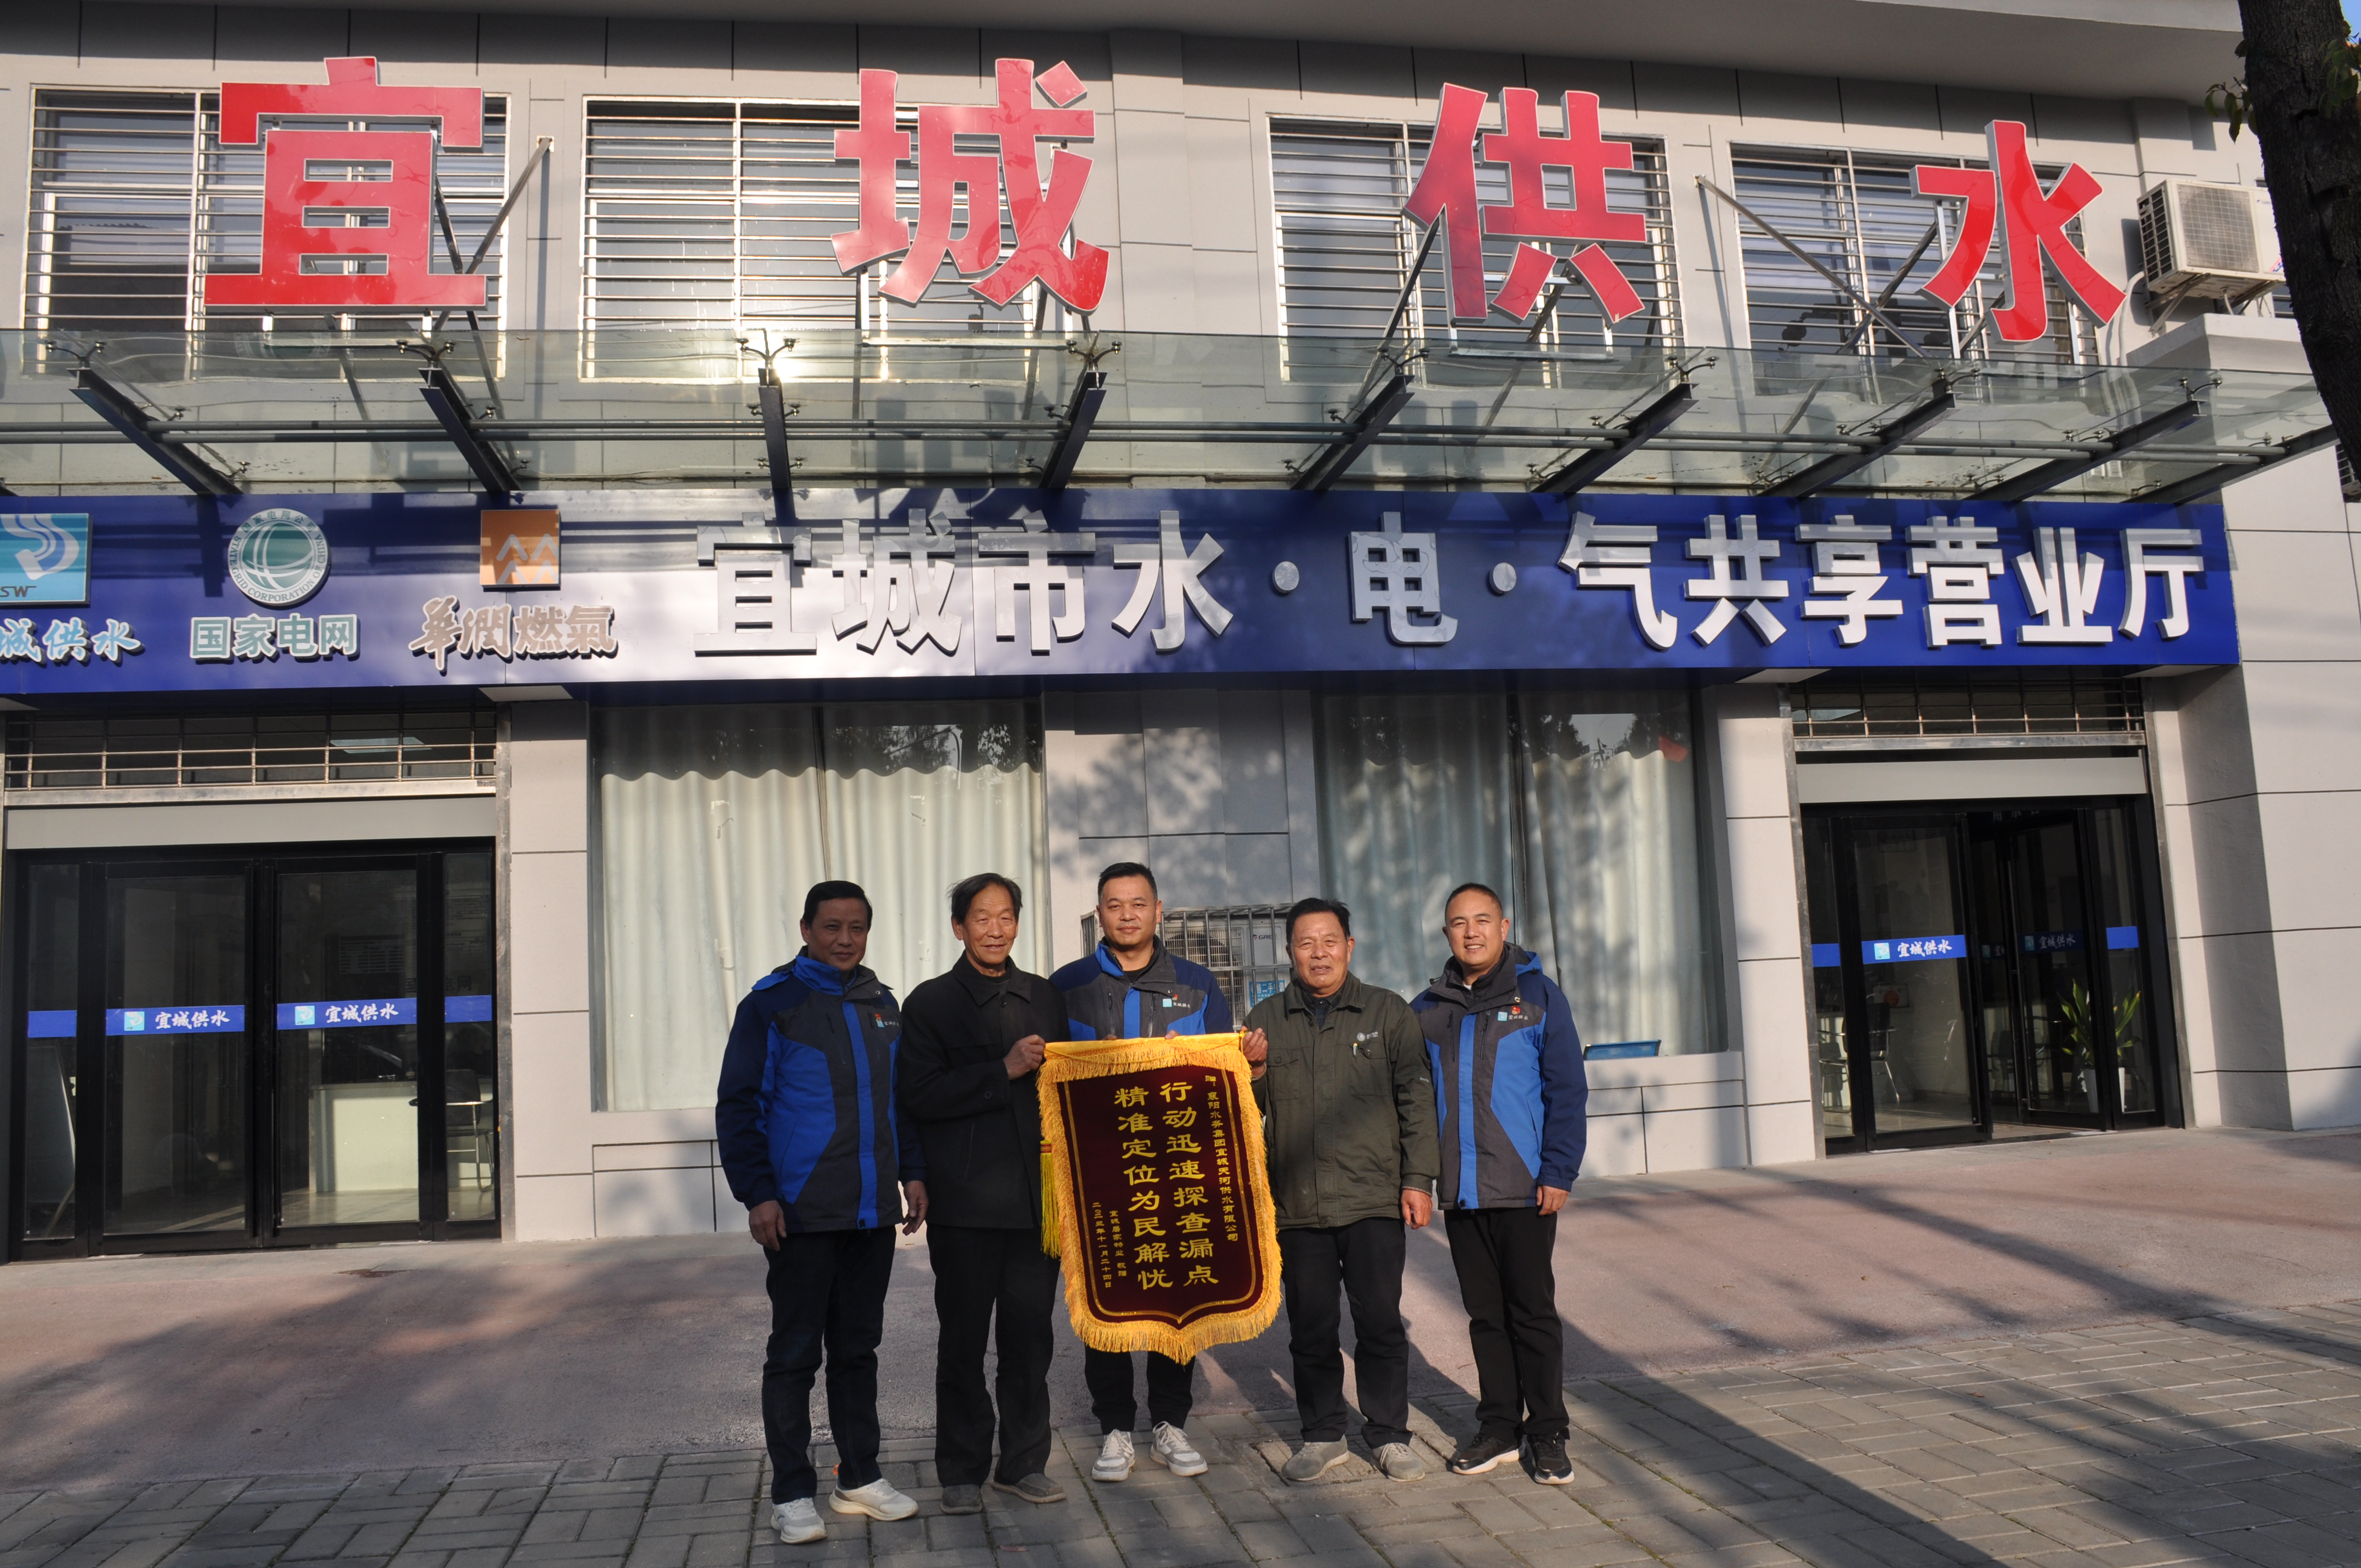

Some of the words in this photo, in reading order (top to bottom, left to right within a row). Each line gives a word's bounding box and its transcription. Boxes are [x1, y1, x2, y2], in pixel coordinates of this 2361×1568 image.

[204, 56, 2126, 342] 宜城供水
[230, 536, 242, 565] STATE
[314, 534, 326, 564] CHINA
[232, 567, 248, 589] GRID
[313, 565, 323, 578] OF
[248, 581, 315, 602] CORPORATION
[190, 613, 357, 658] 国家电网
[1897, 939, 1952, 958] 宜城供水
[155, 1010, 230, 1030] 宜城供水
[325, 1003, 399, 1023] 宜城供水
[1114, 1086, 1173, 1290] 精准定位为民解忧
[1160, 1082, 1218, 1287] 行动迅速探查漏点
